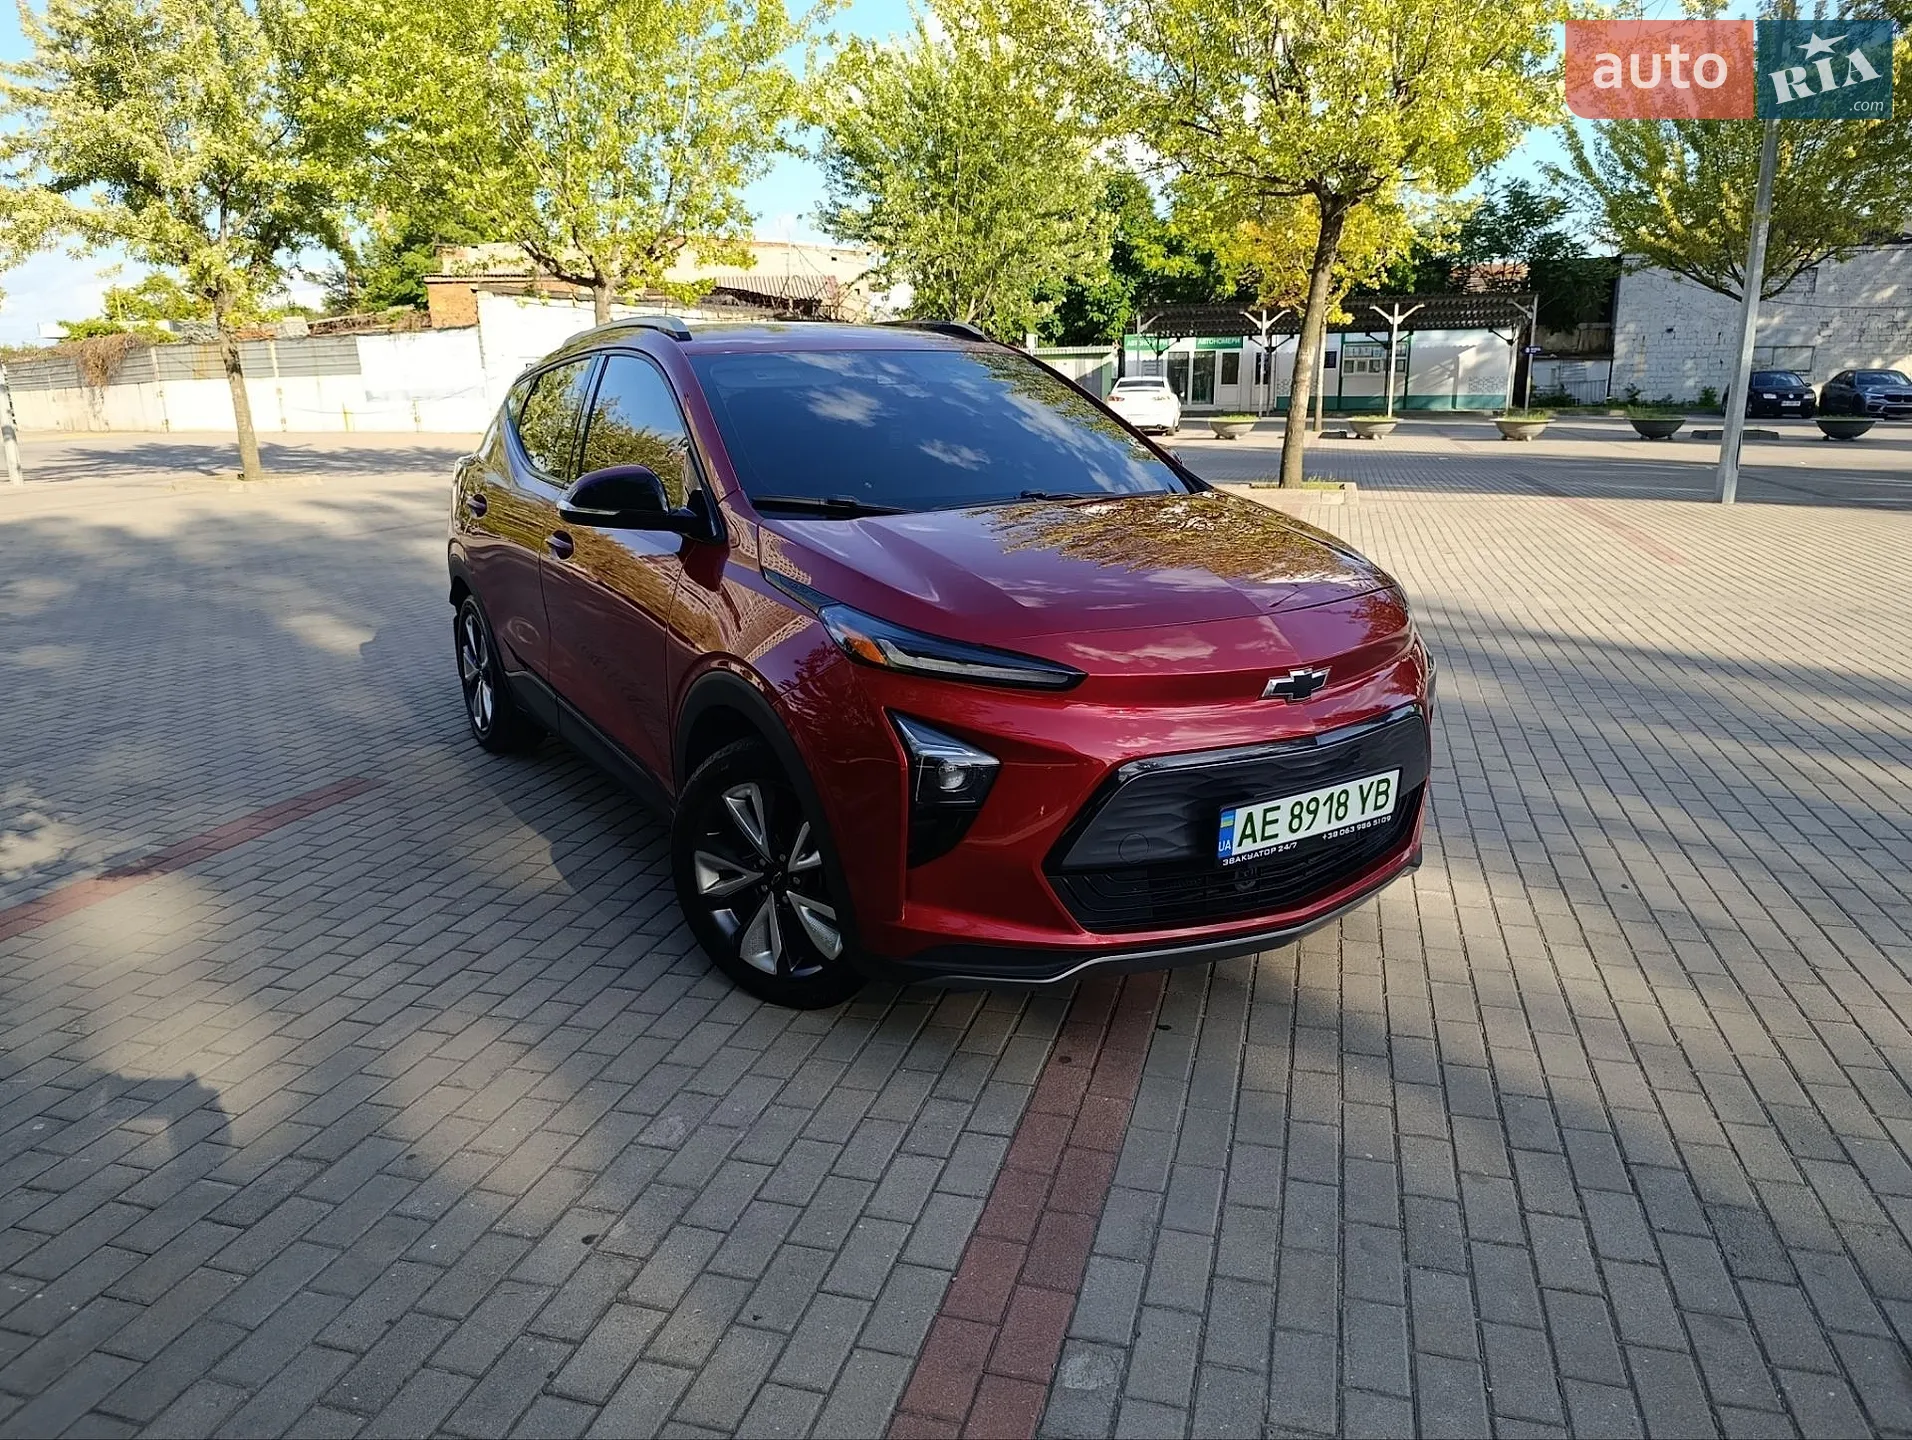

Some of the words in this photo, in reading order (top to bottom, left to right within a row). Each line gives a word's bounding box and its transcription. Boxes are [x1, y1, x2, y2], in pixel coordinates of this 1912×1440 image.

[1237, 805, 1281, 847] AE
[1288, 789, 1349, 834] 8918
[1359, 777, 1391, 815] YB
[1322, 830, 1338, 840] +38
[1218, 840, 1232, 852] UA
[1277, 841, 1298, 852] 24/7
